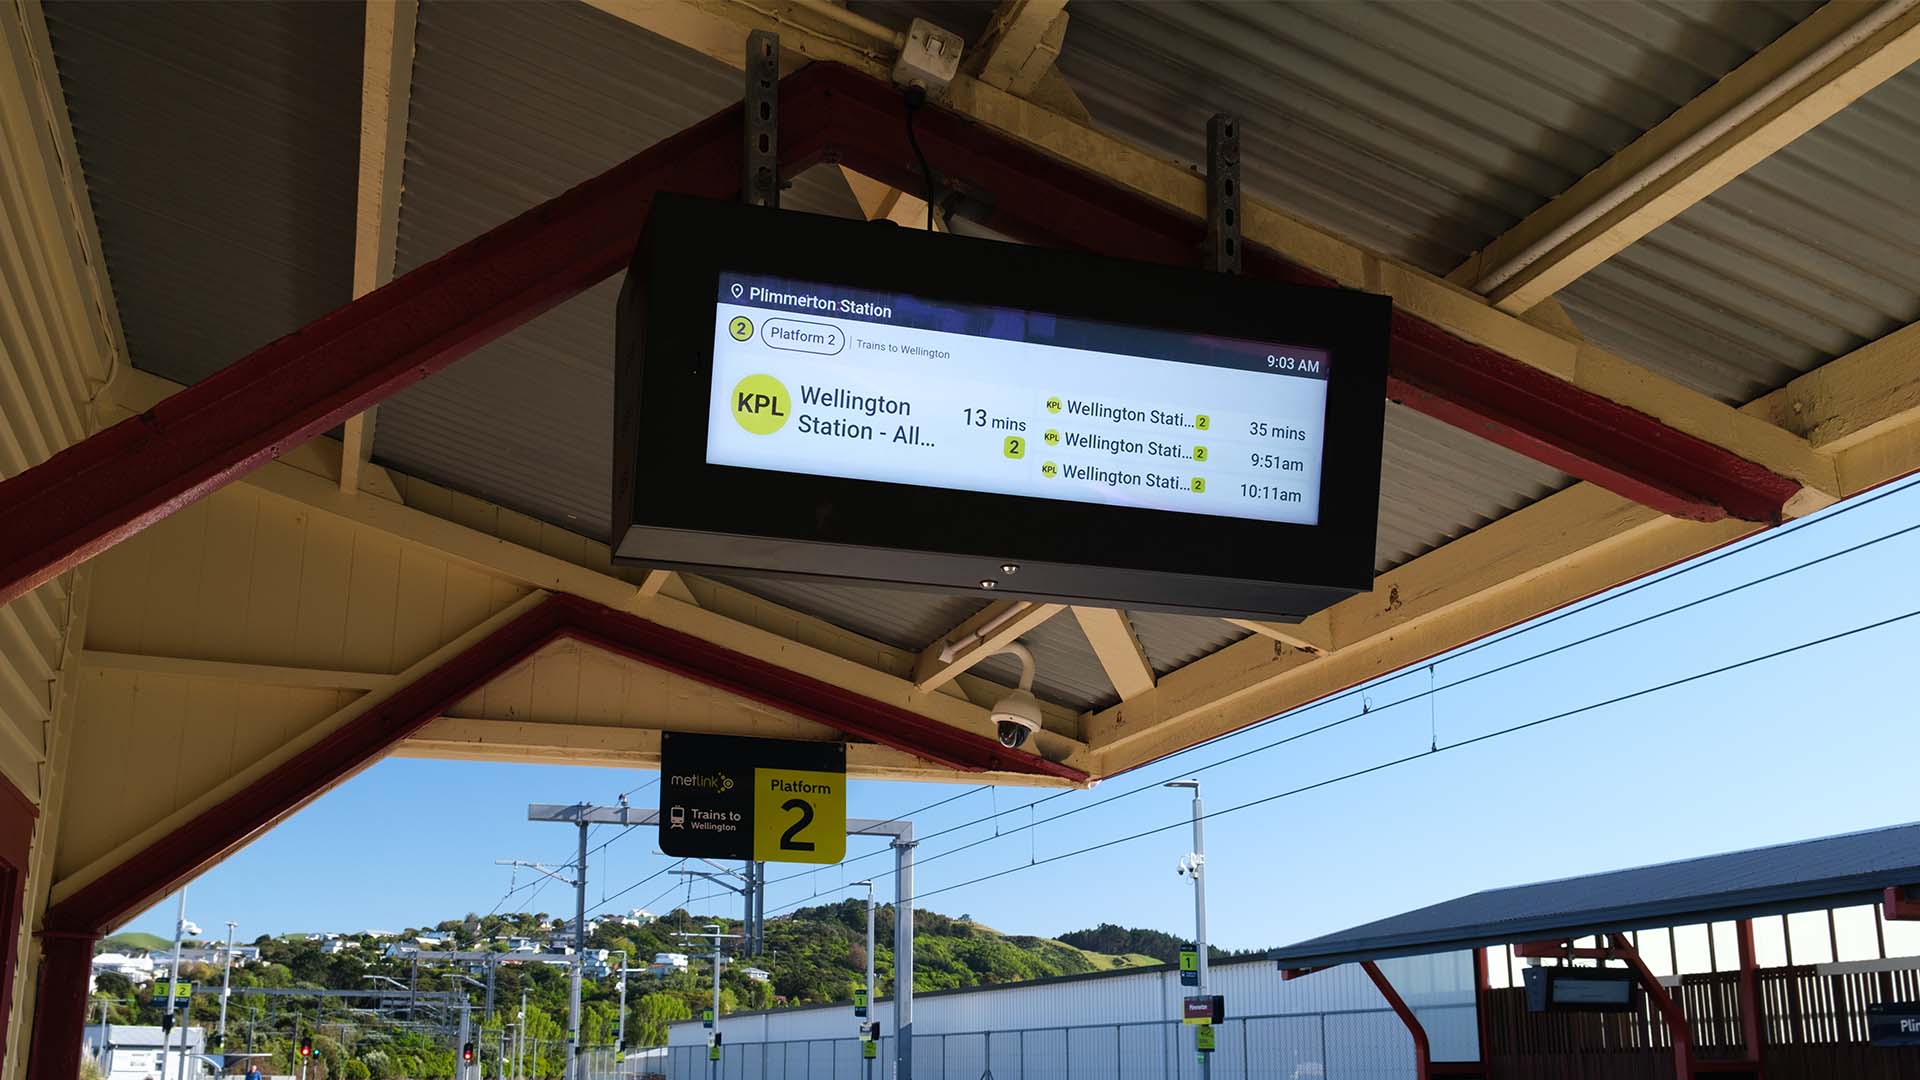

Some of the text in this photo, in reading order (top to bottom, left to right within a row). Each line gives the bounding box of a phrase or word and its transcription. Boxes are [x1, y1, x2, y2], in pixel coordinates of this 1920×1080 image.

[750, 287, 892, 318] Plimmerton Station
[737, 322, 746, 335] 2
[771, 327, 835, 346] Platform 2
[857, 339, 950, 359] Trains to Wellington
[1267, 355, 1319, 373] 9:03 AM
[737, 392, 784, 416] KPL
[800, 385, 910, 416] Wellington
[963, 408, 1026, 431] 13 mins
[1047, 401, 1061, 409] KPL
[1068, 400, 1145, 422] Wellington
[799, 415, 872, 440] Station
[1200, 418, 1206, 427] 2
[1250, 422, 1306, 441] 35 mins
[1010, 440, 1019, 453] 2
[1044, 433, 1059, 441] KPL
[1065, 432, 1143, 454] Wellington
[1197, 450, 1203, 458] 2
[1251, 454, 1303, 471] 9:51am
[1042, 465, 1057, 474] KPL
[1063, 464, 1140, 487] Wellington
[1195, 480, 1200, 490] 2
[1240, 484, 1301, 502] 10:11am
[672, 774, 717, 787] metlink
[771, 780, 830, 794] Platform
[692, 809, 741, 821] Trains to
[691, 822, 736, 832] Wellington
[780, 799, 815, 851] 2
[1186, 957, 1190, 968] 1
[180, 987, 185, 995] 2
